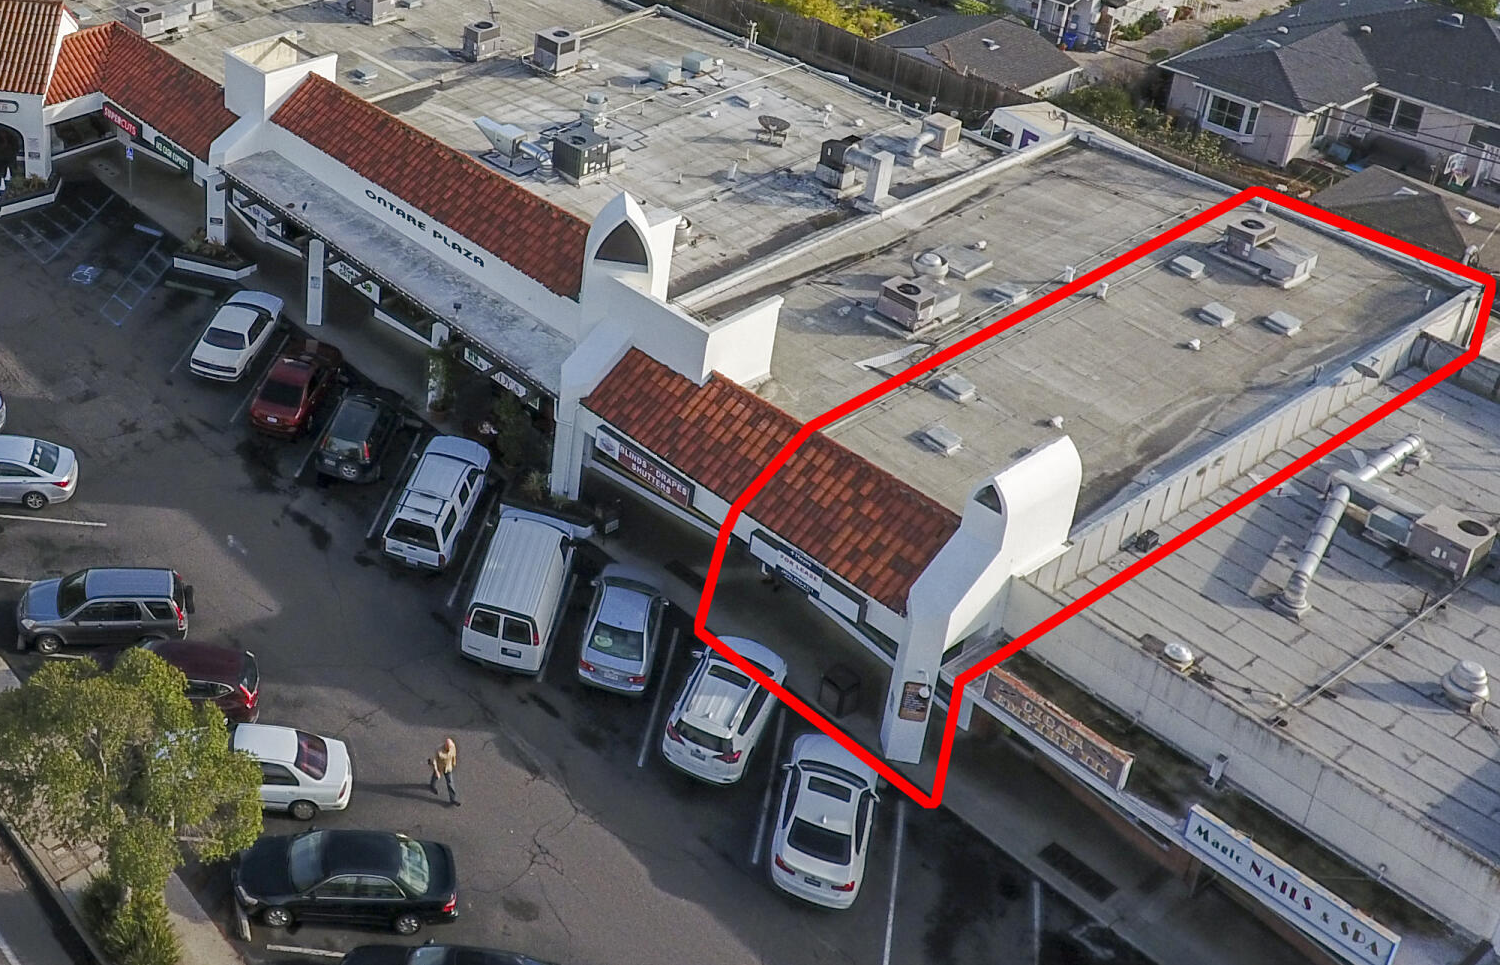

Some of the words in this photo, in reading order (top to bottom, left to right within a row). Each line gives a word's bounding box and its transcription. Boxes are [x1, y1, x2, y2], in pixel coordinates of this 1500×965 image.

[104, 106, 137, 136] SUPERCUTS
[365, 189, 426, 232] ONTARE
[433, 229, 485, 268] PLAZA
[620, 445, 648, 469] BLINDS
[655, 469, 687, 496] DRAPES
[631, 462, 671, 495] SHUTTERS
[780, 554, 794, 566] FOR
[795, 564, 819, 582] LEASE
[1022, 699, 1083, 750] CIGAR
[1194, 823, 1243, 865] Magic
[1249, 859, 1314, 912] NAILS
[1338, 920, 1379, 957] SPA
